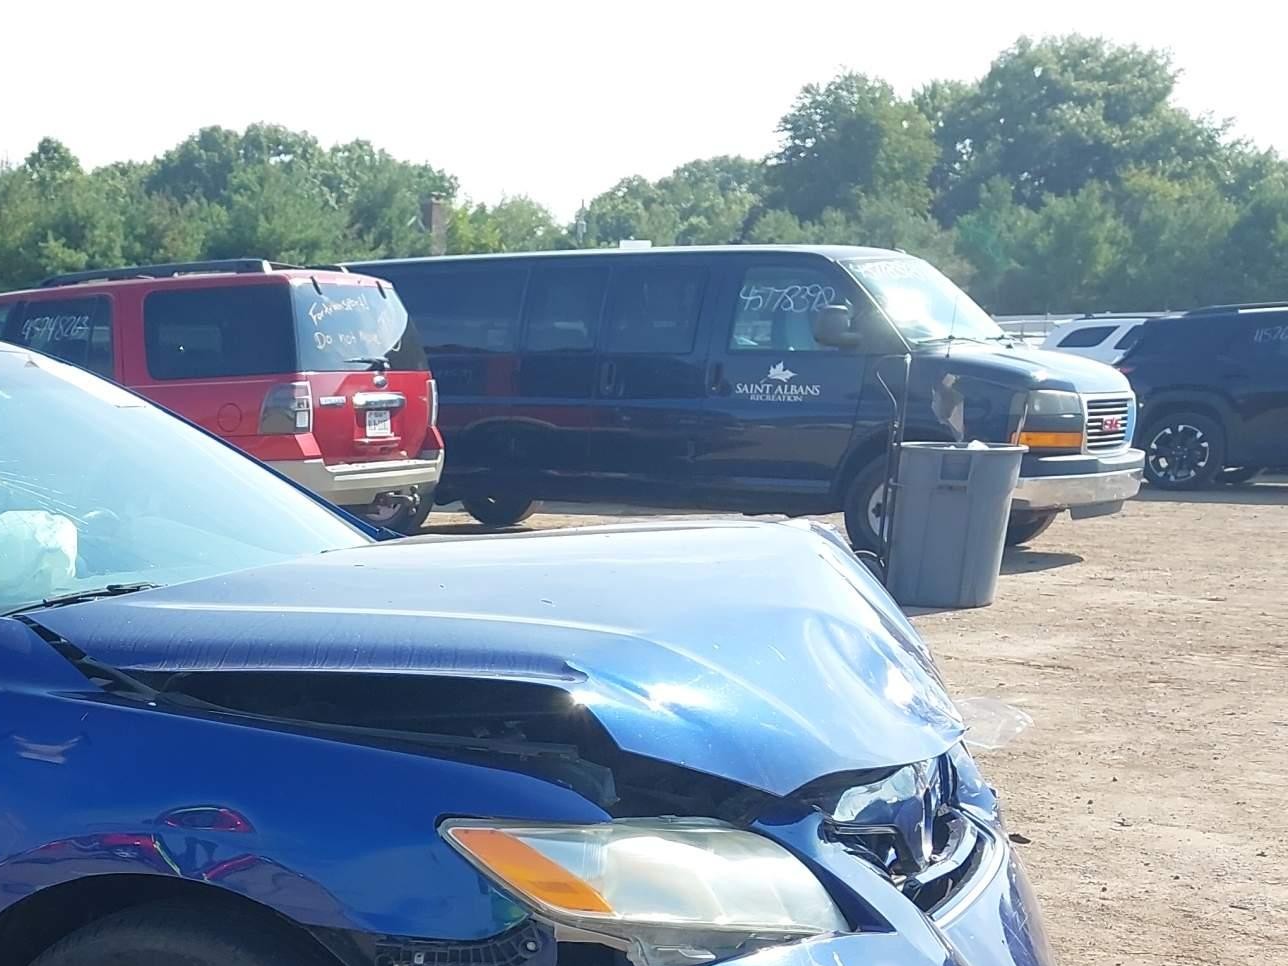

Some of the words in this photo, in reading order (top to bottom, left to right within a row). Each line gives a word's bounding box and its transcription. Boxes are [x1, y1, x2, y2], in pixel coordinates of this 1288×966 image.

[314, 332, 333, 350] Do
[735, 383, 773, 395] SAINT
[774, 384, 821, 396] ALBANS
[750, 394, 803, 402] RECREATION
